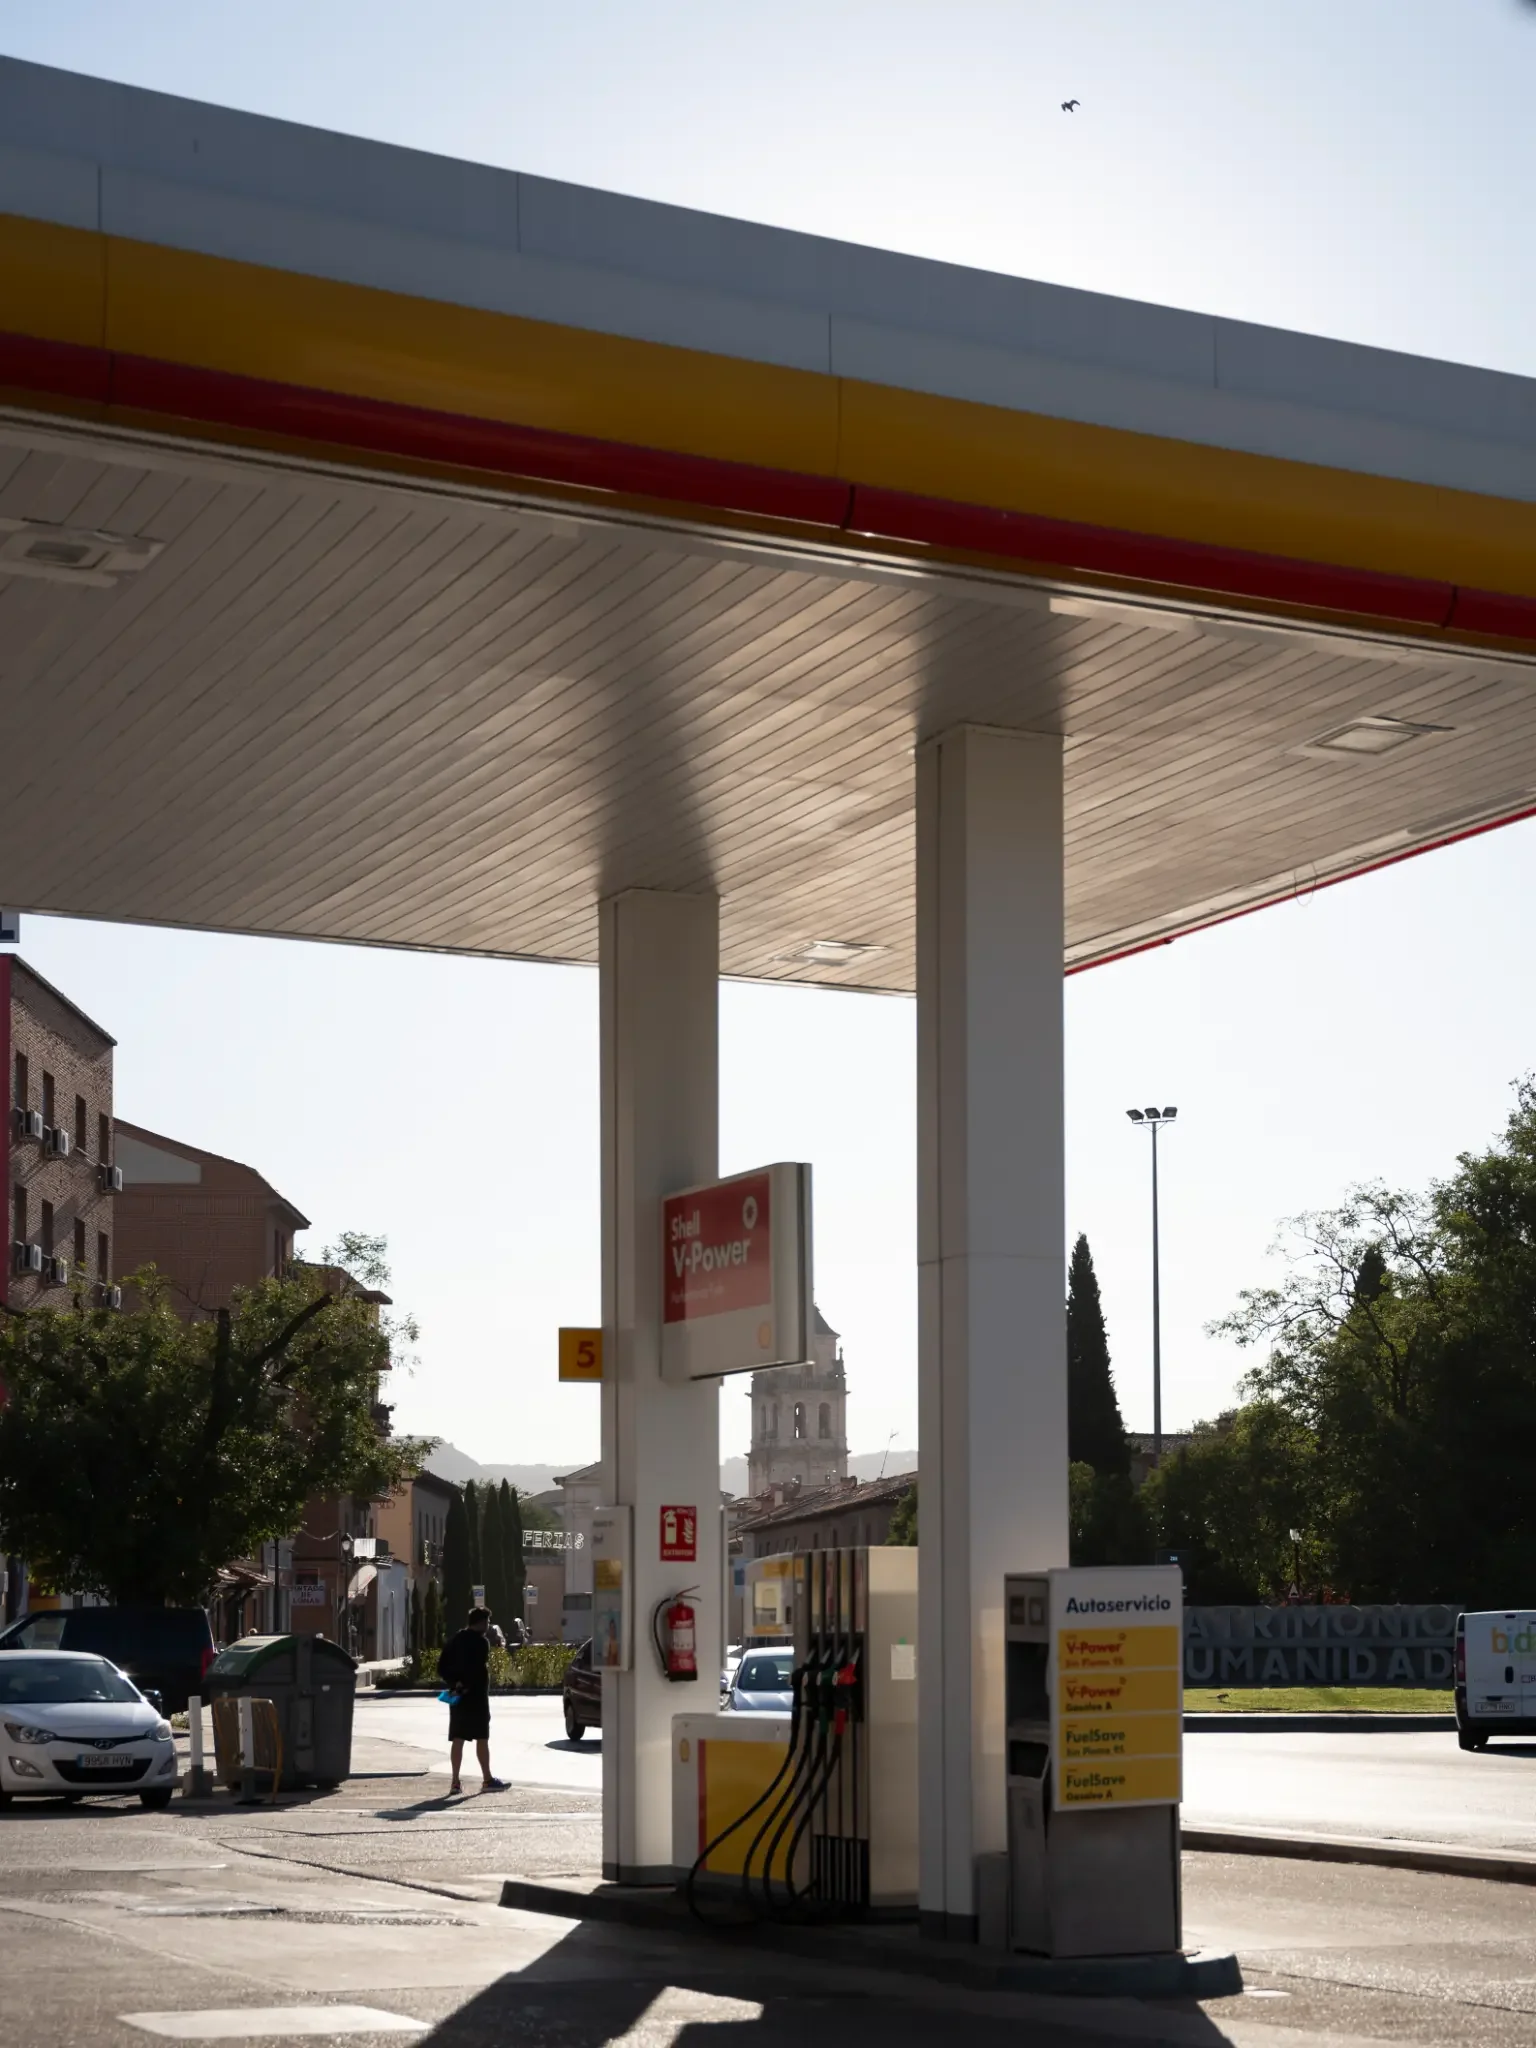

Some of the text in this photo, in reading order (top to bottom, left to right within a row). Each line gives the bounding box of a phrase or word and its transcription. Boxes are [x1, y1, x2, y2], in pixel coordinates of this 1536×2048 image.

[671, 1209, 700, 1241] Shell
[672, 1239, 752, 1278] V-Power
[577, 1341, 596, 1369] 5
[522, 1529, 585, 1550] FERIAS
[1066, 1594, 1171, 1614] Autoservicio
[1065, 1641, 1122, 1655] V-Power
[1490, 1626, 1536, 1654] bid
[1185, 1646, 1452, 1681] UMANIDAD
[1065, 1685, 1122, 1699] V-Power
[1105, 1701, 1113, 1710] A
[1066, 1728, 1126, 1744] FuelSave
[1066, 1773, 1126, 1788] FuelSave
[1105, 1789, 1113, 1799] A
